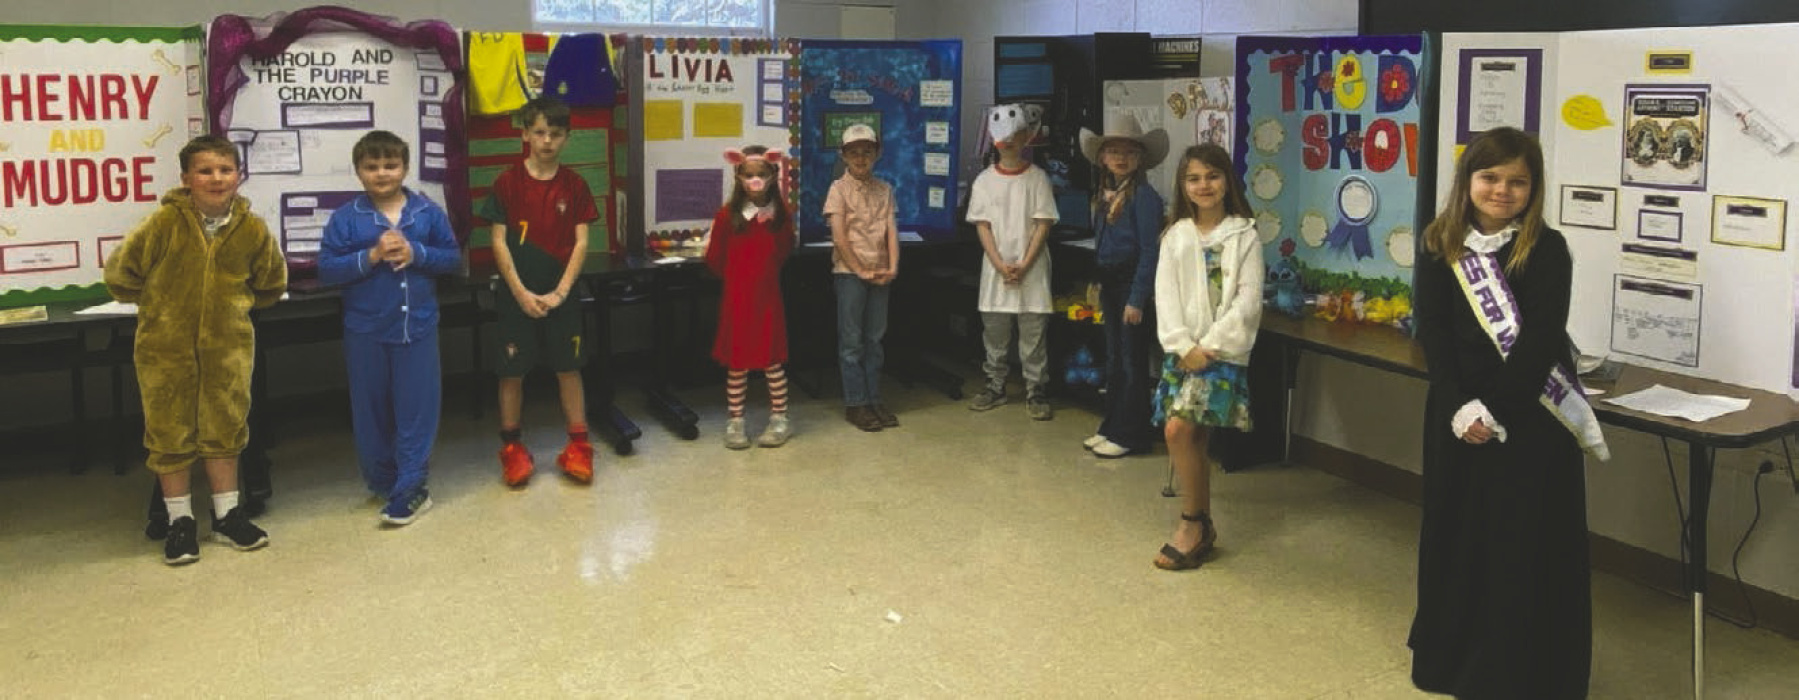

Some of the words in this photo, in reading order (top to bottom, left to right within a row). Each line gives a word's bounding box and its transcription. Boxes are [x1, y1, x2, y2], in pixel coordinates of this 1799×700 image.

[252, 52, 336, 67] HAROLD
[352, 49, 394, 65] AND
[649, 54, 734, 83] LIVIA
[254, 68, 296, 84] THE
[310, 68, 390, 85] PURPLE
[1376, 54, 1420, 113] D
[0, 73, 161, 121] HENRY
[278, 86, 363, 101] CRAYON
[48, 128, 106, 153] AND
[3, 156, 158, 208] MUDGE
[519, 221, 529, 246] 7
[1474, 285, 1505, 324] FOR
[571, 336, 581, 359] 7
